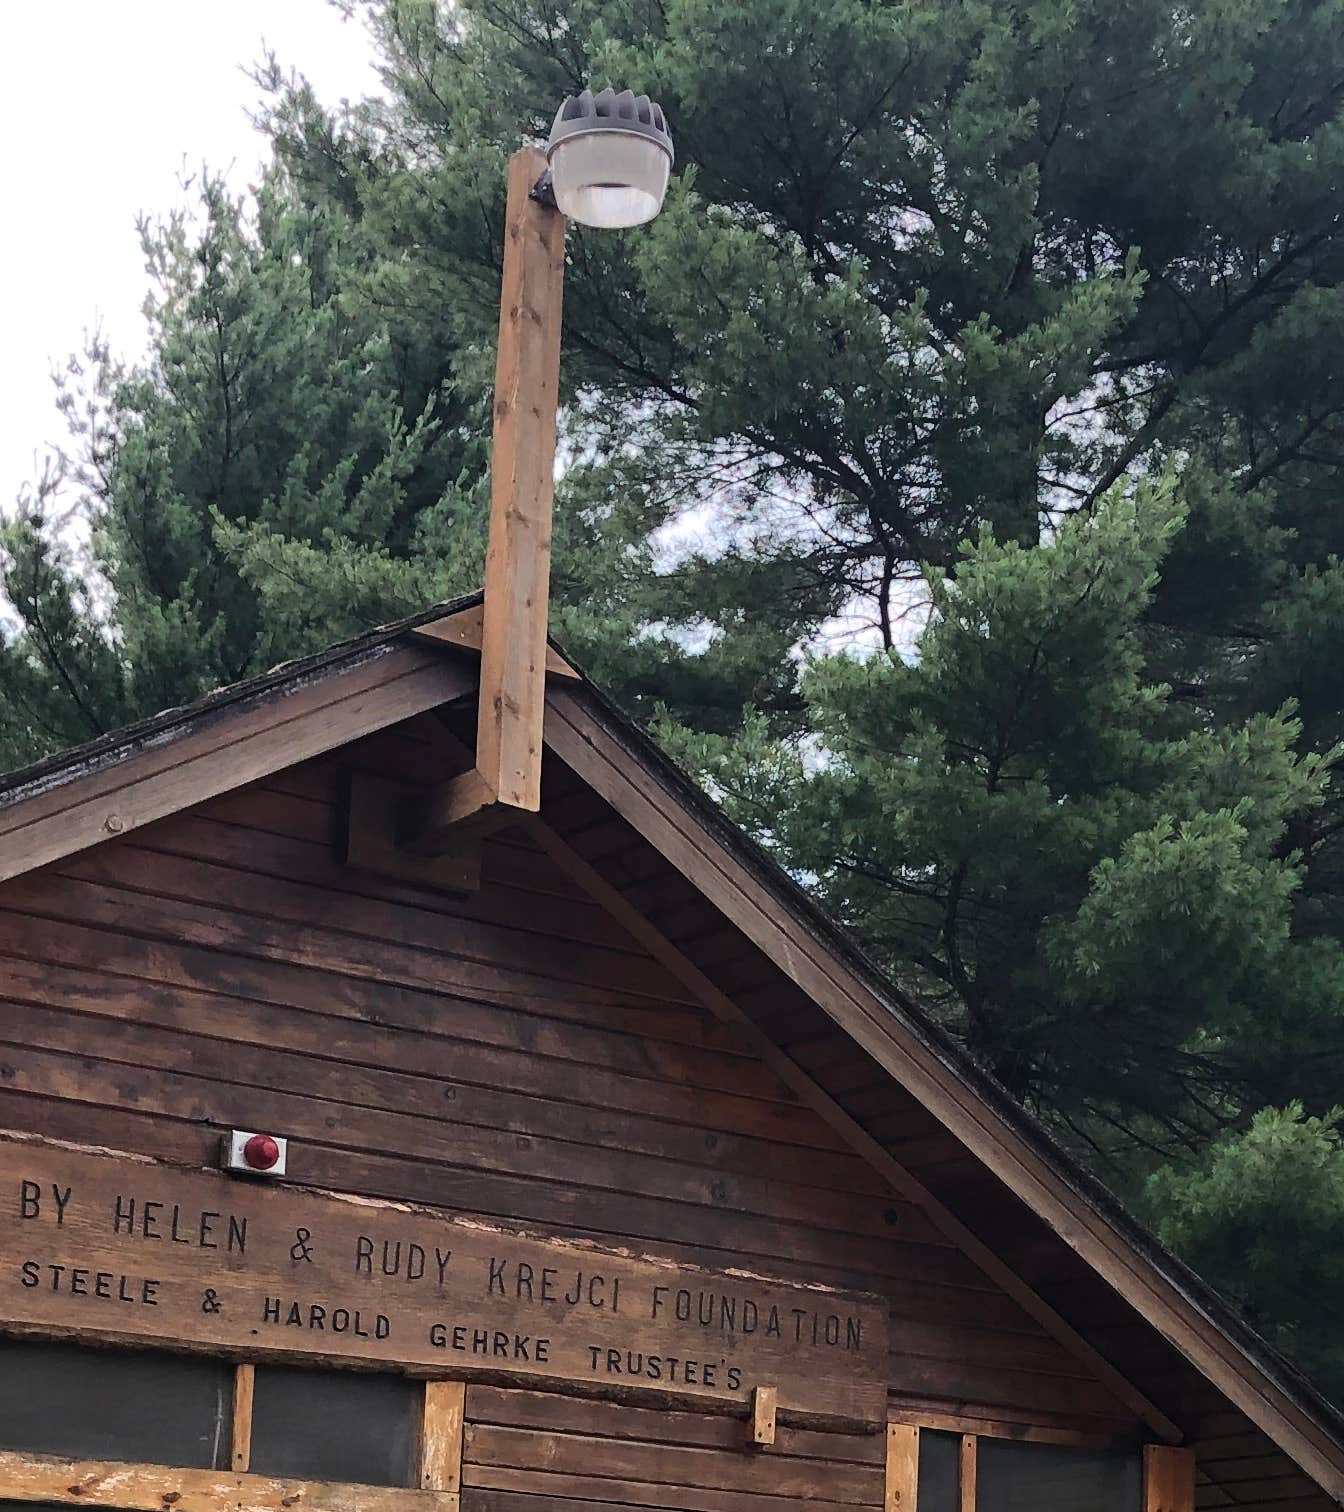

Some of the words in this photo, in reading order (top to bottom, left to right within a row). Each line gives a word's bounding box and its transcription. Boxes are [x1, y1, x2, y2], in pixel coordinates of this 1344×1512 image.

[20, 1179, 73, 1225] BY
[113, 1195, 248, 1254] HELEN
[290, 1227, 314, 1263] &
[355, 1236, 452, 1285] RUDY
[487, 1257, 619, 1313] KREJCI
[651, 1286, 862, 1350] FOUNDATION
[20, 1261, 160, 1306] STEELE
[201, 1288, 222, 1314] &
[263, 1297, 391, 1340] HAROLD
[429, 1323, 551, 1363] GEHRKE
